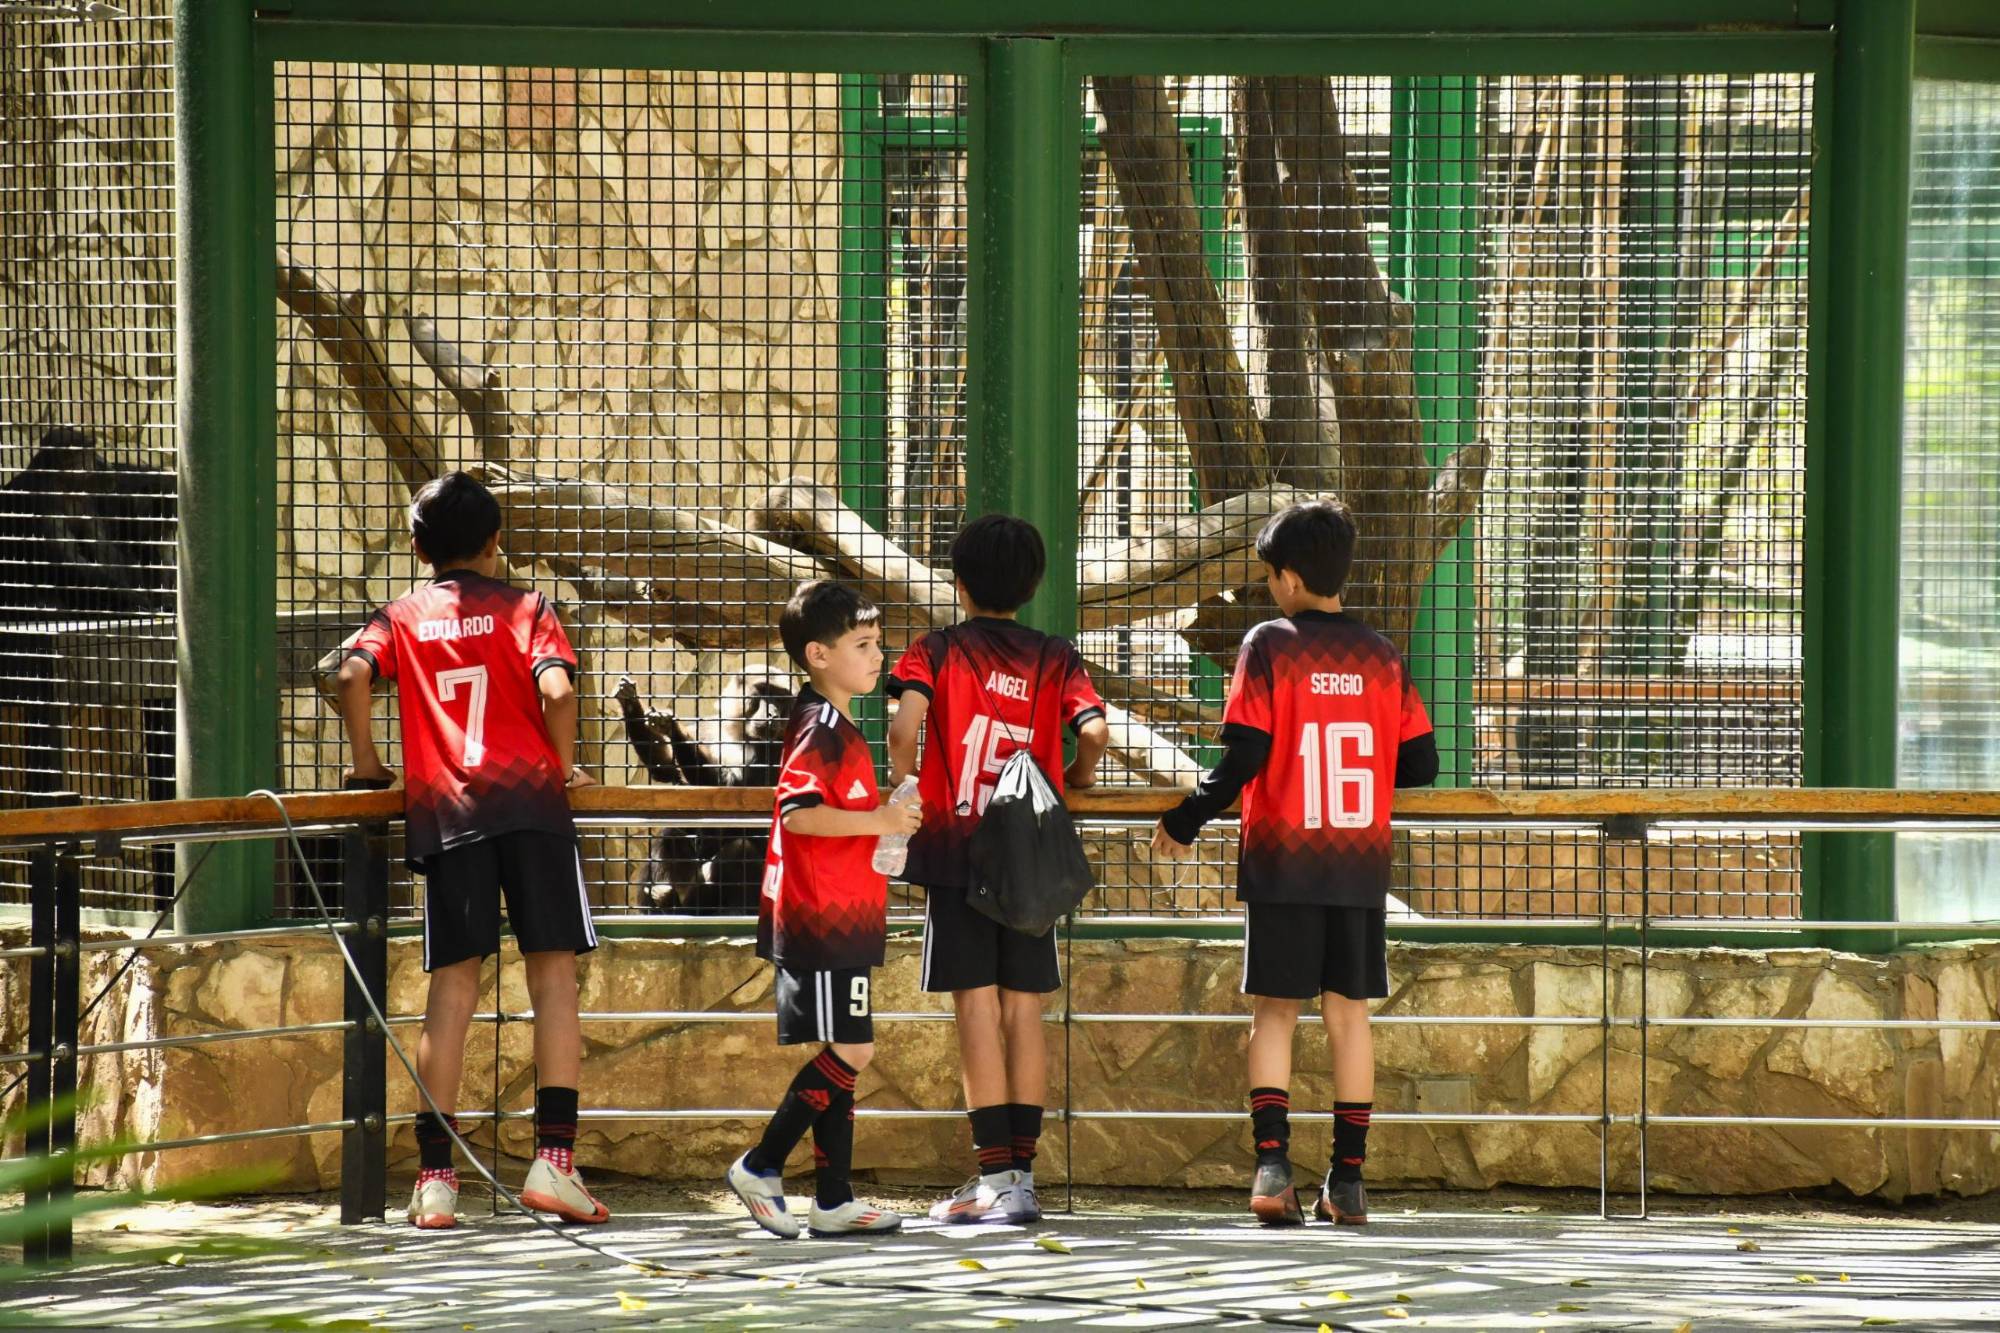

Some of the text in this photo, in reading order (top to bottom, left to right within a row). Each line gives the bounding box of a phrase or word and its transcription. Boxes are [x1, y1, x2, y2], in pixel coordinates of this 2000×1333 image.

[418, 614, 494, 642] EDUARDO
[985, 670, 1029, 702] ANGEL
[1311, 672, 1363, 696] SERGIO
[435, 664, 488, 767] 7
[1298, 721, 1374, 829] 16
[849, 976, 869, 1017] 9
